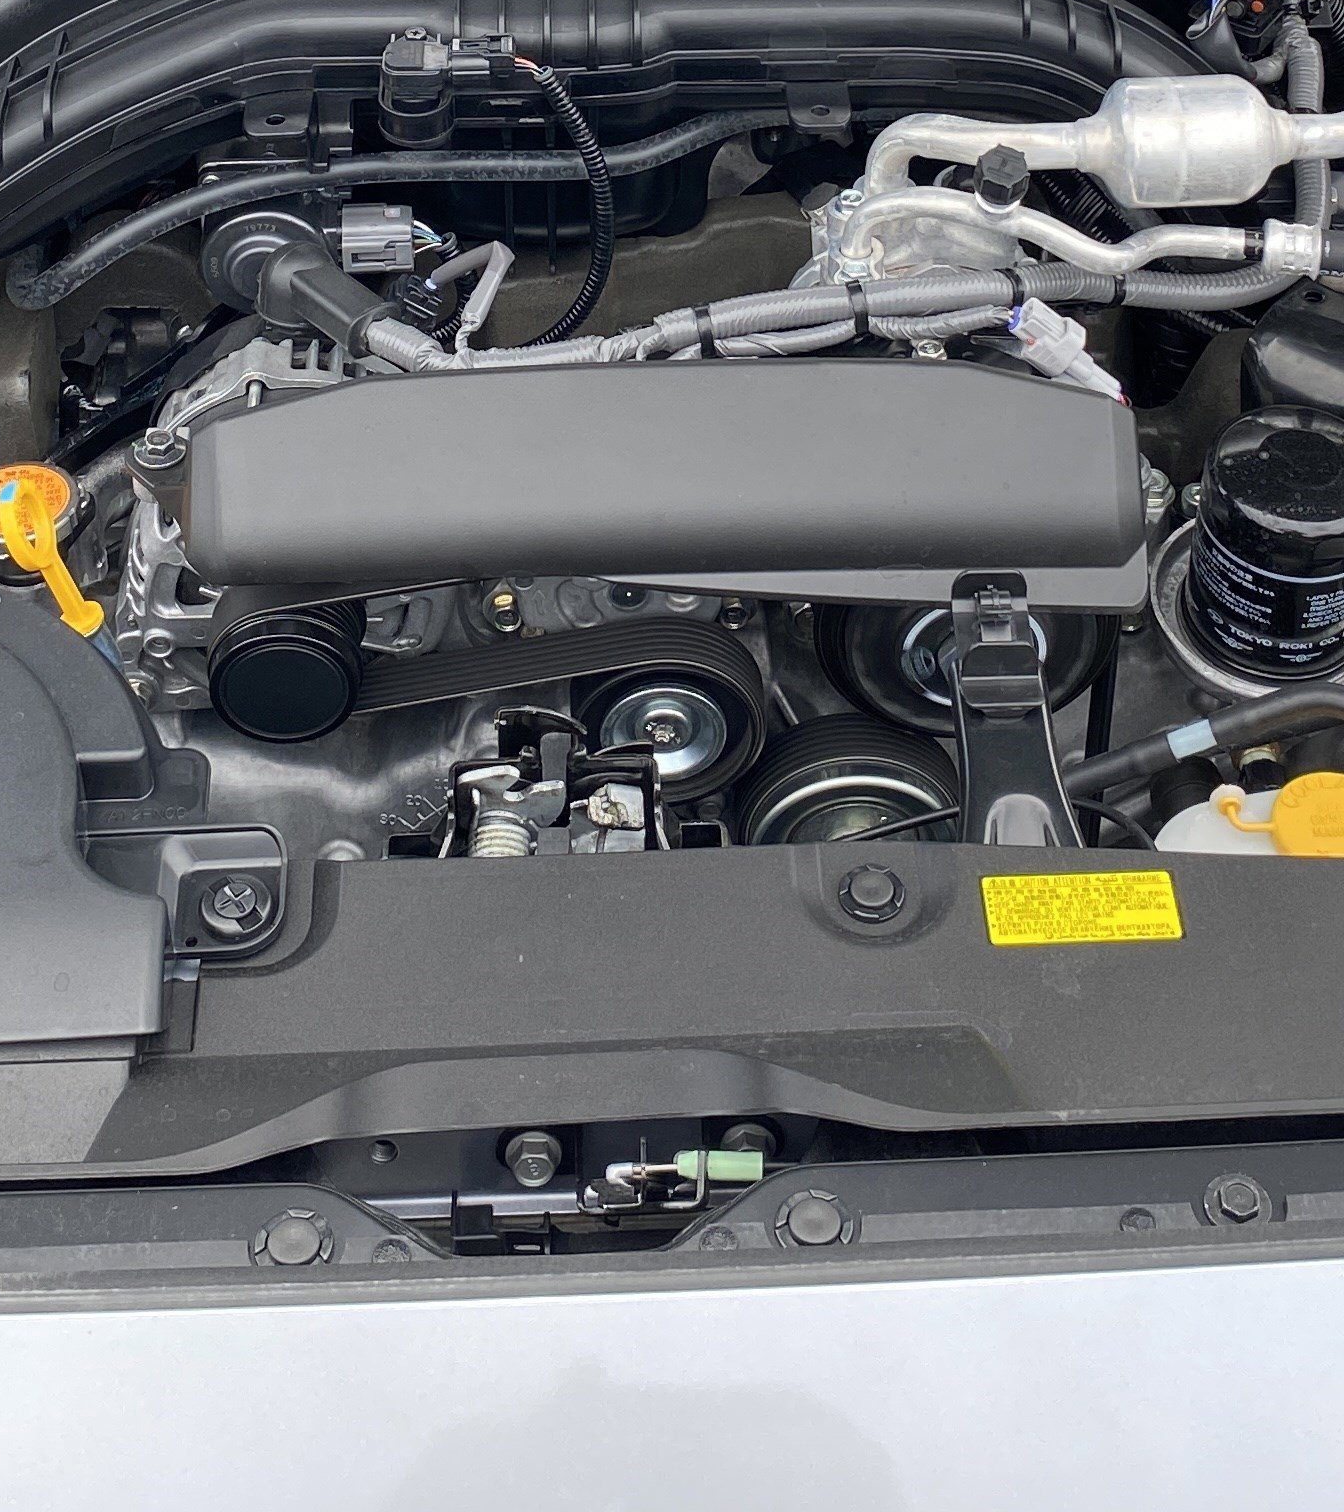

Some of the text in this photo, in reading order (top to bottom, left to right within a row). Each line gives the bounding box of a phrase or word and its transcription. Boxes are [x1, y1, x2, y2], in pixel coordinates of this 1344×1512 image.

[1228, 623, 1273, 647] TOKYO
[1279, 642, 1313, 650] ROKI
[406, 794, 422, 806] 20
[379, 813, 396, 826] 30
